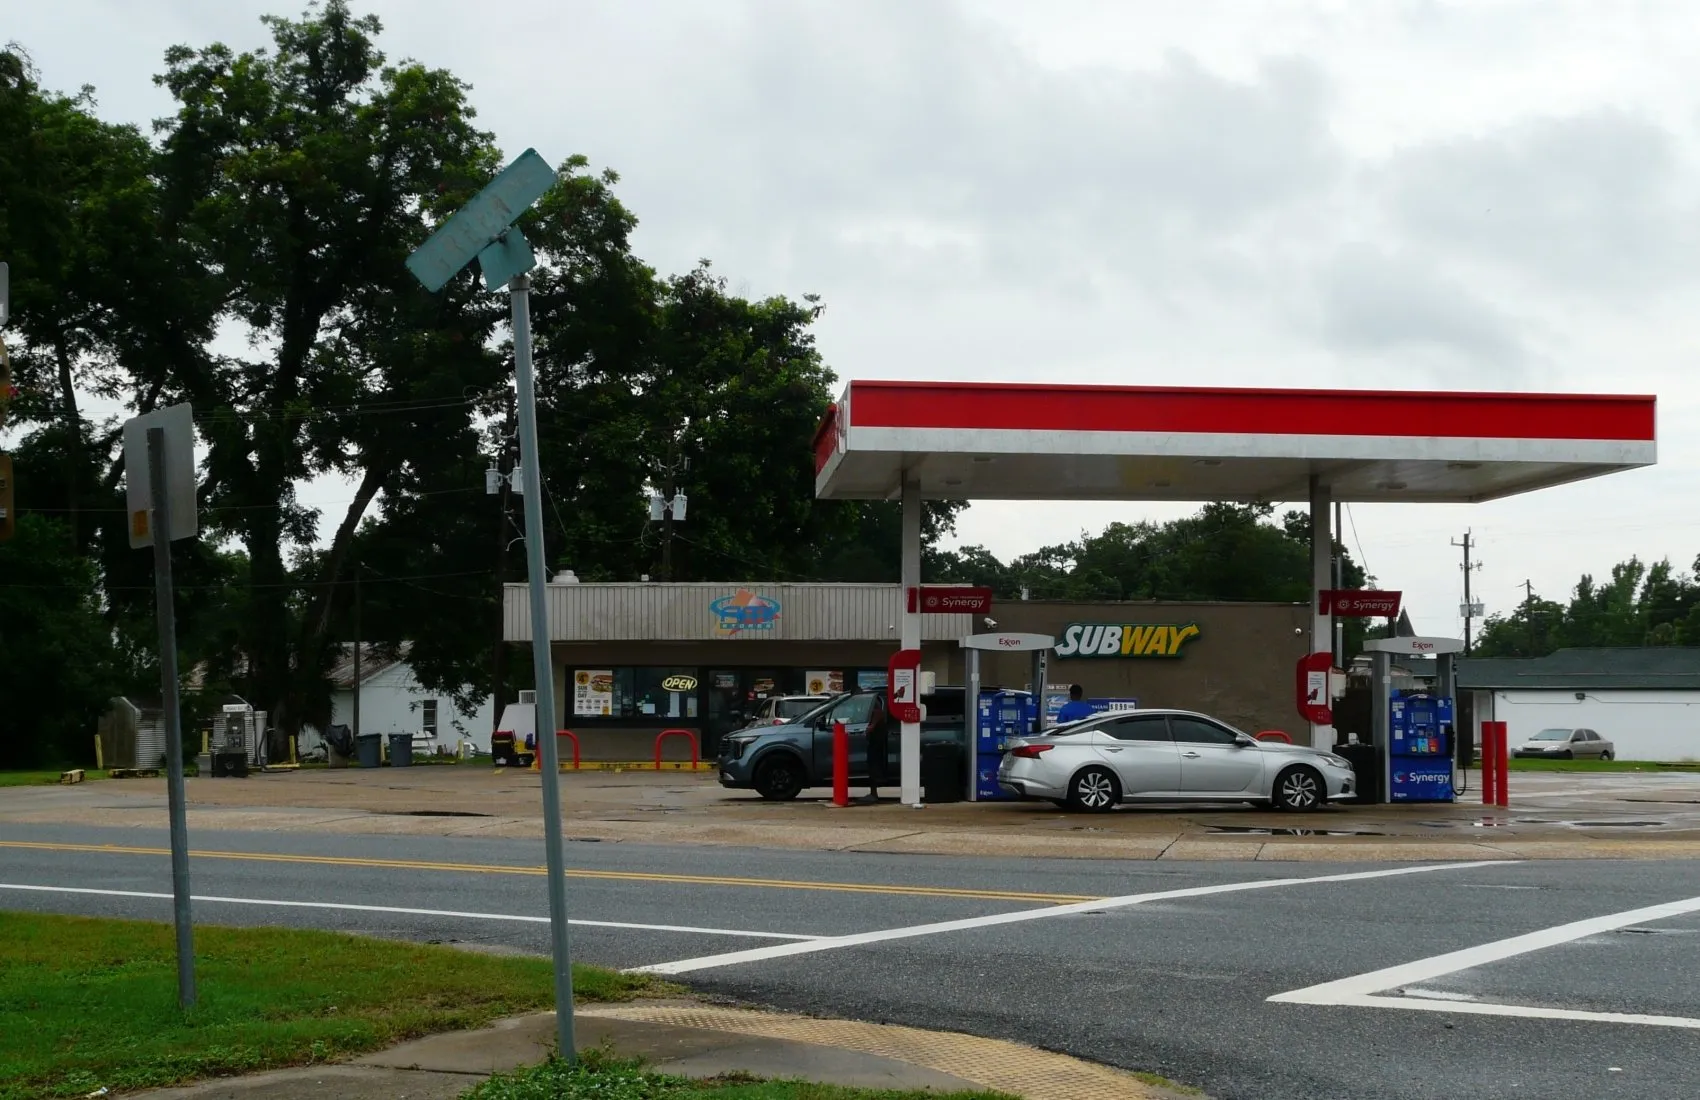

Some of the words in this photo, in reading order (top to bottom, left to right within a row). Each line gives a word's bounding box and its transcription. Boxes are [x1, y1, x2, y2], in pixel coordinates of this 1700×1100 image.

[942, 597, 984, 609] Synergy
[1353, 601, 1395, 611] Synergy
[998, 638, 1021, 648] Exxon
[1054, 624, 1199, 656] SUBWAY
[1412, 642, 1434, 650] Exxon
[664, 677, 694, 690] OPEN
[1409, 772, 1450, 784] Synergy
